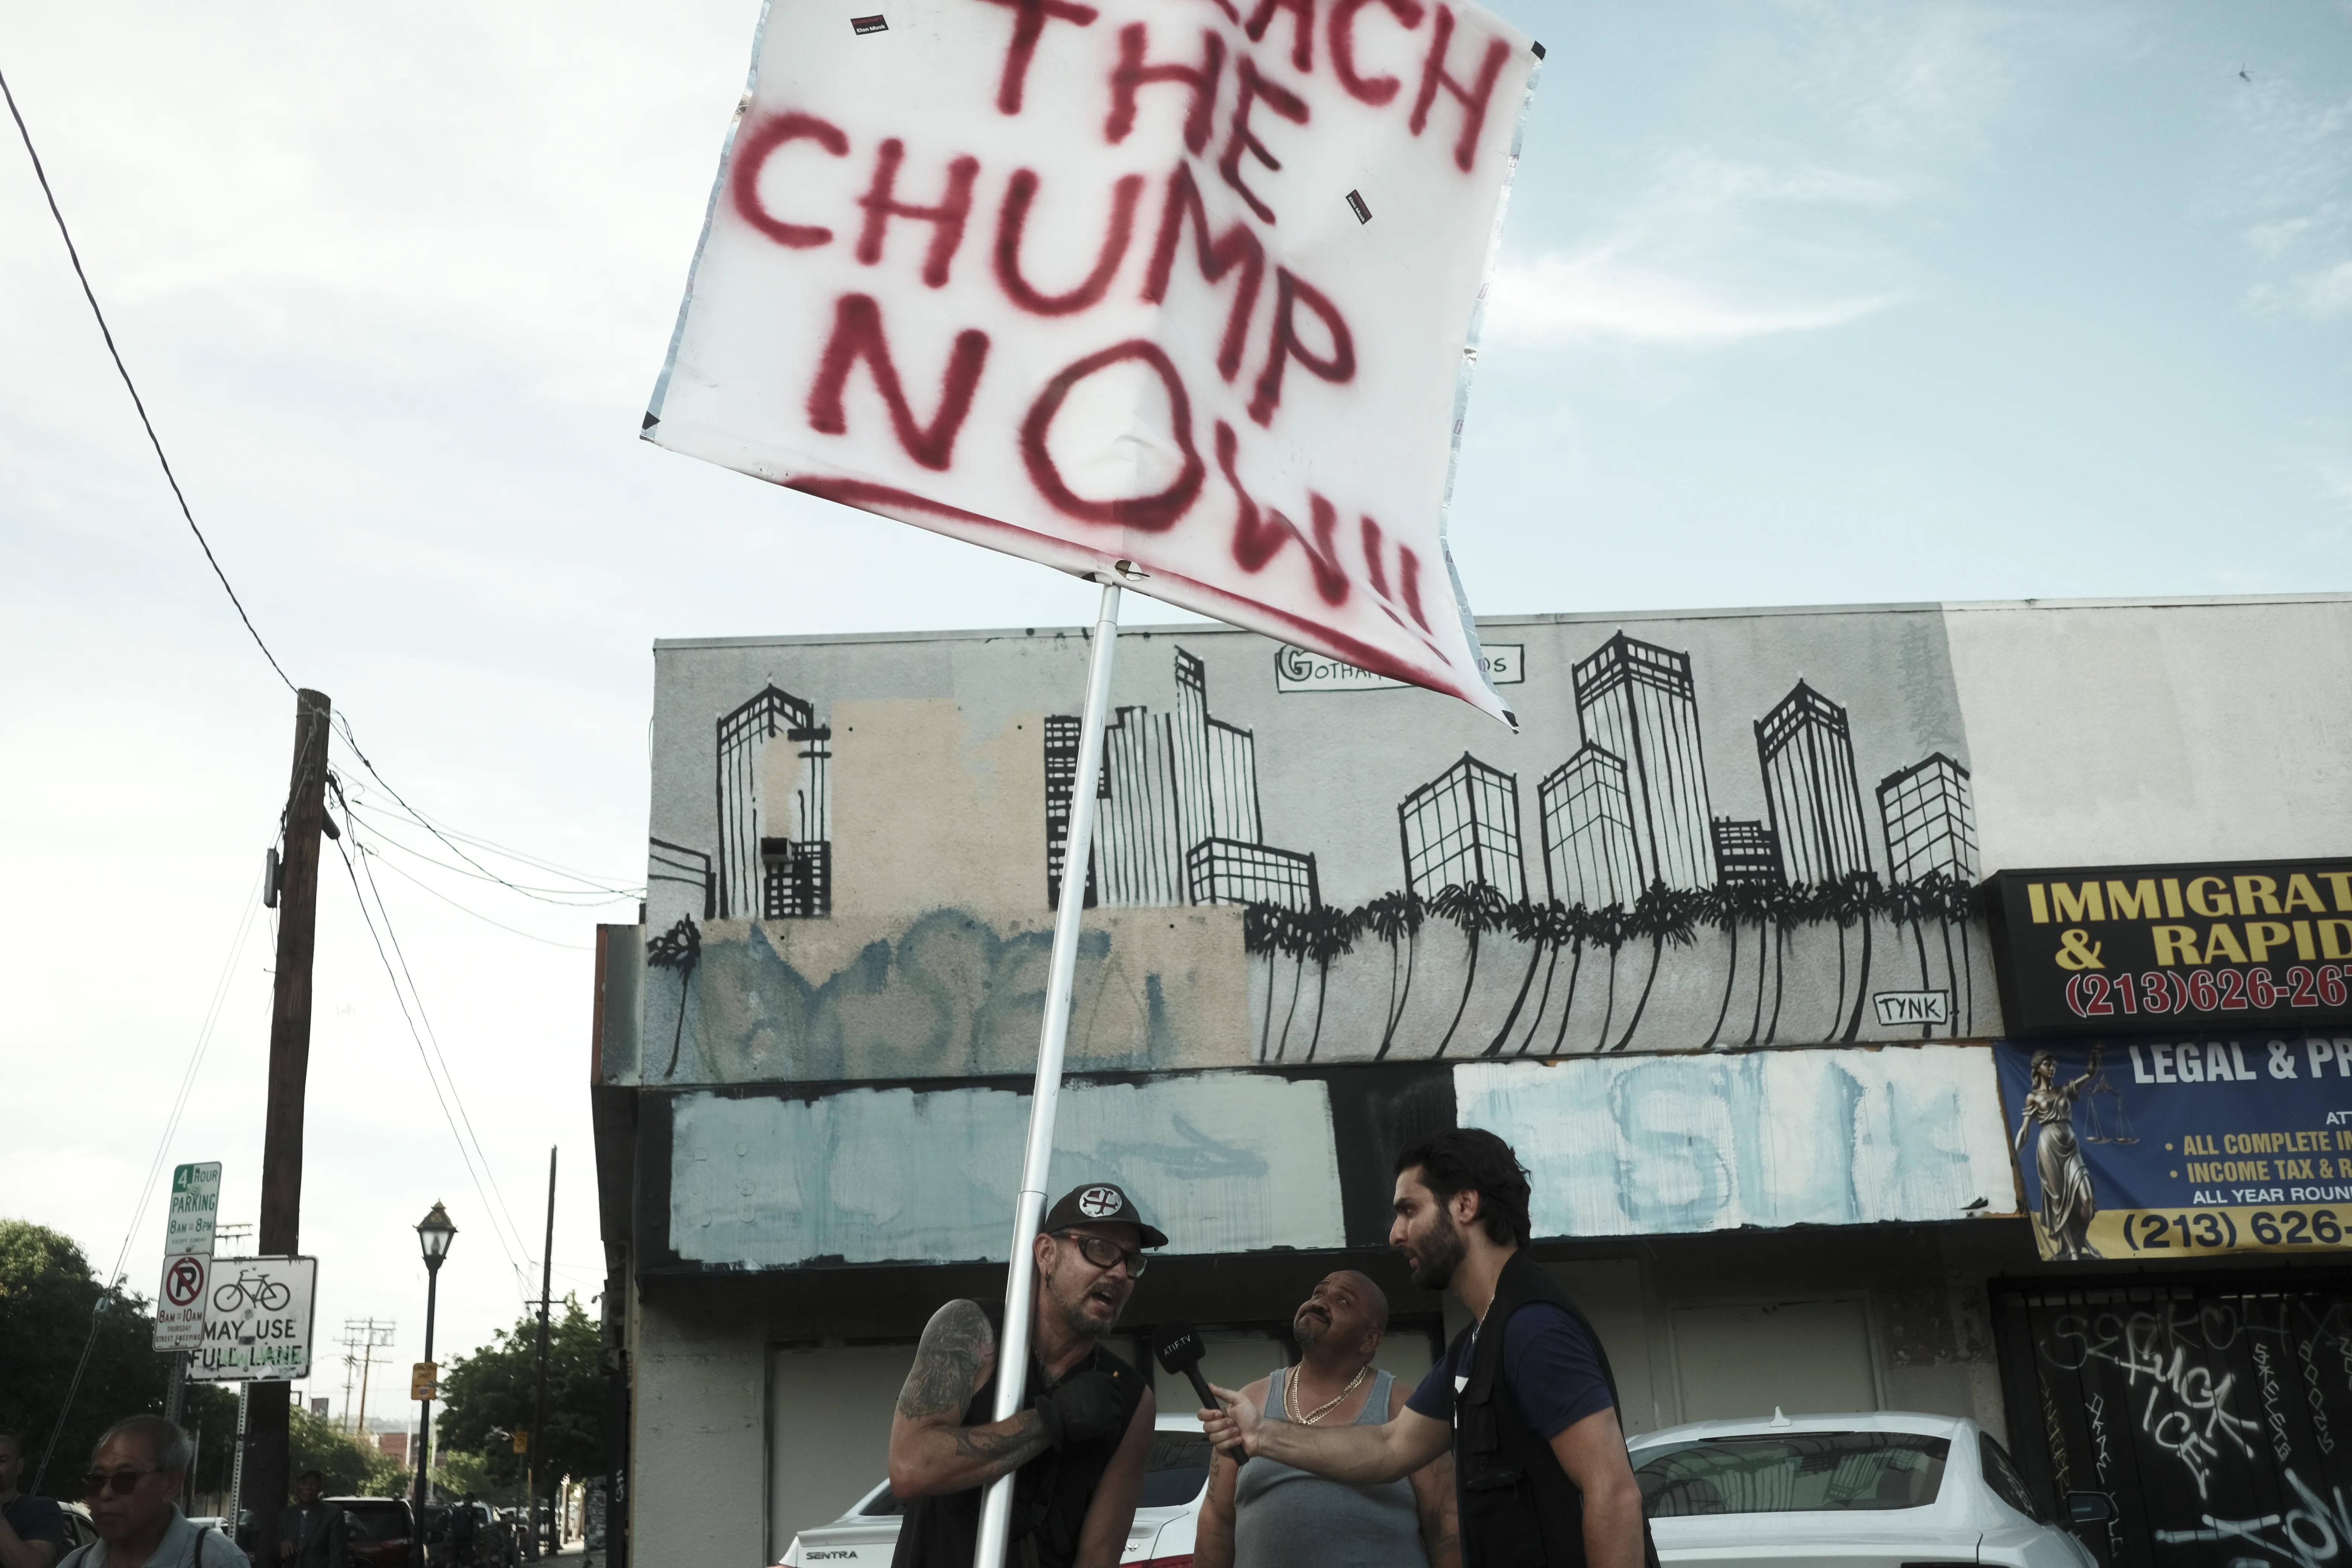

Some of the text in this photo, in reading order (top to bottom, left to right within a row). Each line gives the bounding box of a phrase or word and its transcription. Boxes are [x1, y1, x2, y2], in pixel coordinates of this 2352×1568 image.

[852, 16, 882, 24] BANKRUPT
[972, 0, 1311, 228] THE
[1355, 208, 1364, 222] Musk
[729, 109, 1359, 427] CHUMP
[2027, 871, 2352, 924] IMMIGRAT
[2055, 919, 2352, 971] & RAPID
[2066, 965, 2352, 1018] (213)626-26
[1878, 997, 1941, 1020] TYNK
[2129, 1041, 2257, 1084] LEGAL
[2268, 1040, 2298, 1079] &
[2326, 1111, 2352, 1125] AT
[2184, 1135, 2219, 1155] ALL
[2223, 1131, 2332, 1154] COMPLETE
[178, 1168, 217, 1188] 4 HOUR
[2187, 1161, 2271, 1183] INCOME
[2274, 1159, 2315, 1180] TAX
[2319, 1158, 2334, 1179] &
[172, 1193, 215, 1213] PARKING
[2193, 1186, 2352, 1204] ALL YEAR ROUN
[170, 1220, 187, 1234] 8AM
[196, 1218, 212, 1232] 8PM
[2124, 1212, 2237, 1251] (213)
[159, 1310, 175, 1323] 8AM
[183, 1308, 202, 1322] 10AM
[202, 1319, 296, 1340] MAY USE
[1164, 1334, 1190, 1356] ATIF.TV
[191, 1348, 239, 1368] FULL
[250, 1346, 302, 1366] LANE
[806, 1550, 859, 1560] SENTRA
